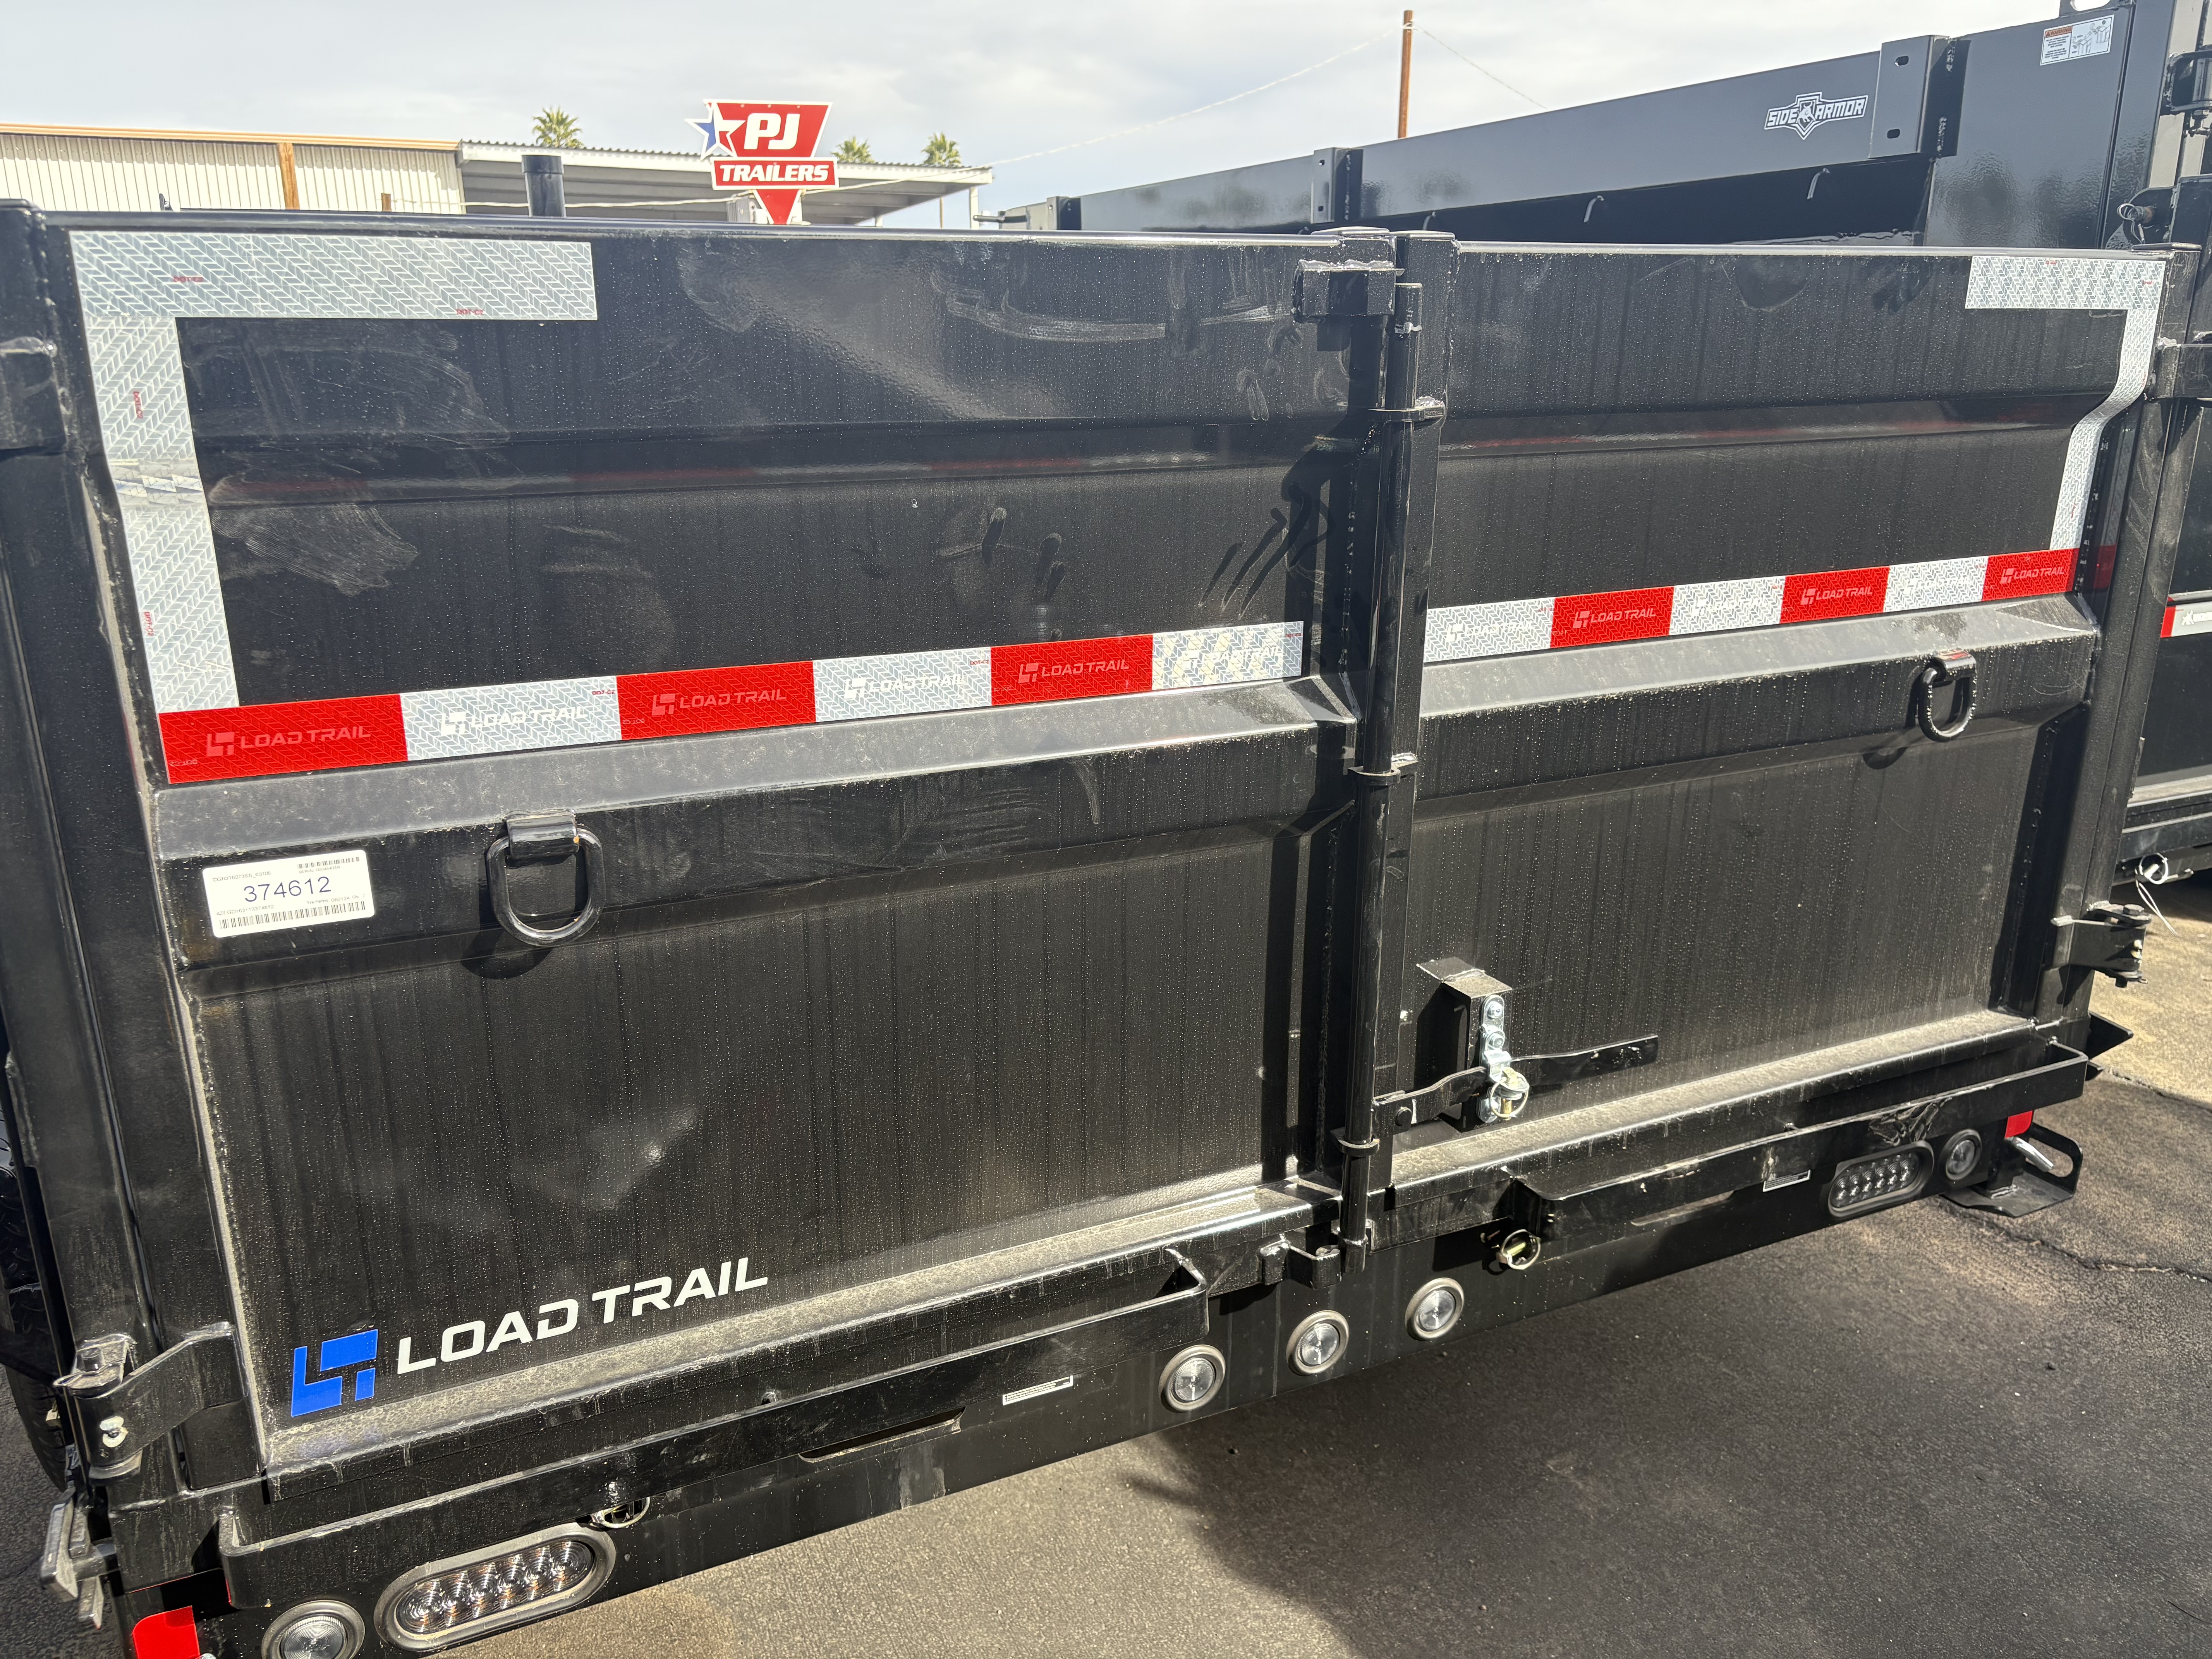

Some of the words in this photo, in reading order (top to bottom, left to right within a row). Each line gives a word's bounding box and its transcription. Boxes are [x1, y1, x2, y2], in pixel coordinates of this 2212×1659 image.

[2050, 27, 2071, 35] WARNING
[1767, 108, 1799, 126] SIDE
[1815, 99, 1865, 120] ARMOR
[744, 113, 800, 150] PJ
[720, 164, 830, 182] TRAILERS
[2014, 569, 2039, 579] LOAD
[2040, 567, 2065, 576] TRAIL
[1816, 589, 1844, 600] LOAD
[1846, 586, 1873, 597] TRAIL
[1590, 611, 1623, 623] LOAD
[1625, 608, 1656, 620] TRAIL
[1041, 663, 1084, 677] LOAD
[1086, 659, 1130, 673] TRAIL
[870, 678, 915, 693] LOAD
[916, 673, 966, 688] TRAIL
[679, 694, 730, 708] LOAD
[732, 689, 787, 704] TRAIL
[471, 712, 526, 727] LOAD
[528, 706, 587, 723] TRAIL
[241, 732, 302, 748] LOAD
[307, 726, 371, 742] TRAIL
[244, 876, 331, 902] 374612
[398, 1299, 579, 1374] LOAD
[592, 1257, 769, 1323] TRAIL
